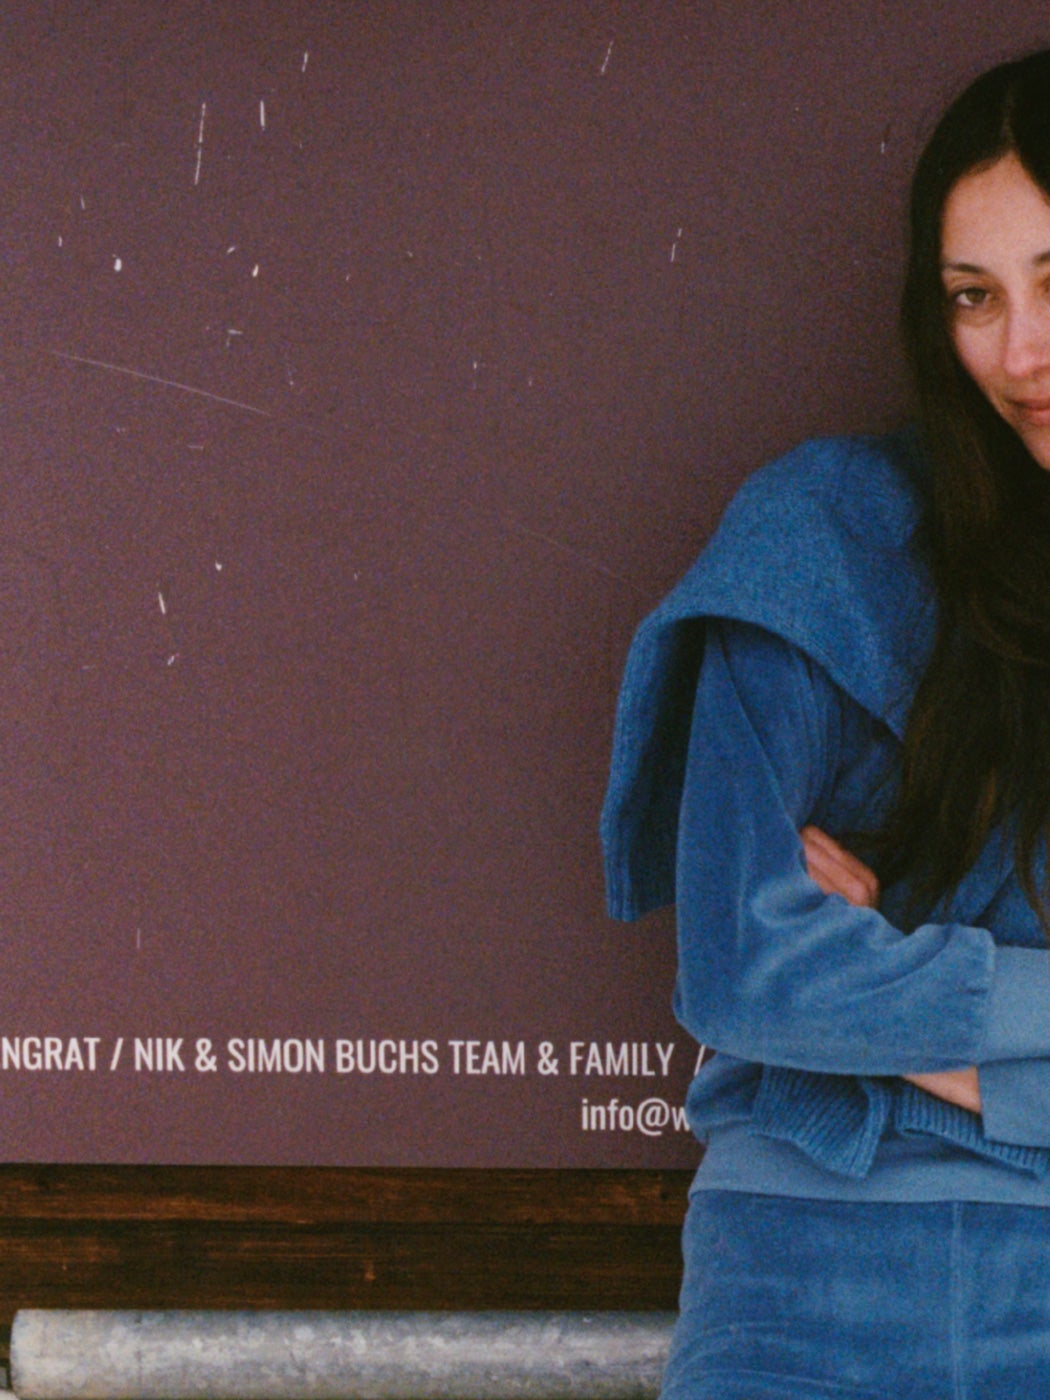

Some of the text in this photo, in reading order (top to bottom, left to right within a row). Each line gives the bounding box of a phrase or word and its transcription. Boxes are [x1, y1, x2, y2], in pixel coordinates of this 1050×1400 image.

[1, 1036, 101, 1071] NGRAT
[110, 1037, 124, 1071] /
[133, 1037, 185, 1072] NIK
[194, 1037, 218, 1072] &
[227, 1038, 325, 1073] SIMON
[335, 1039, 439, 1074] BUCHS
[449, 1040, 526, 1075] TEAM
[537, 1041, 559, 1075] &
[569, 1042, 675, 1076] FAMILY
